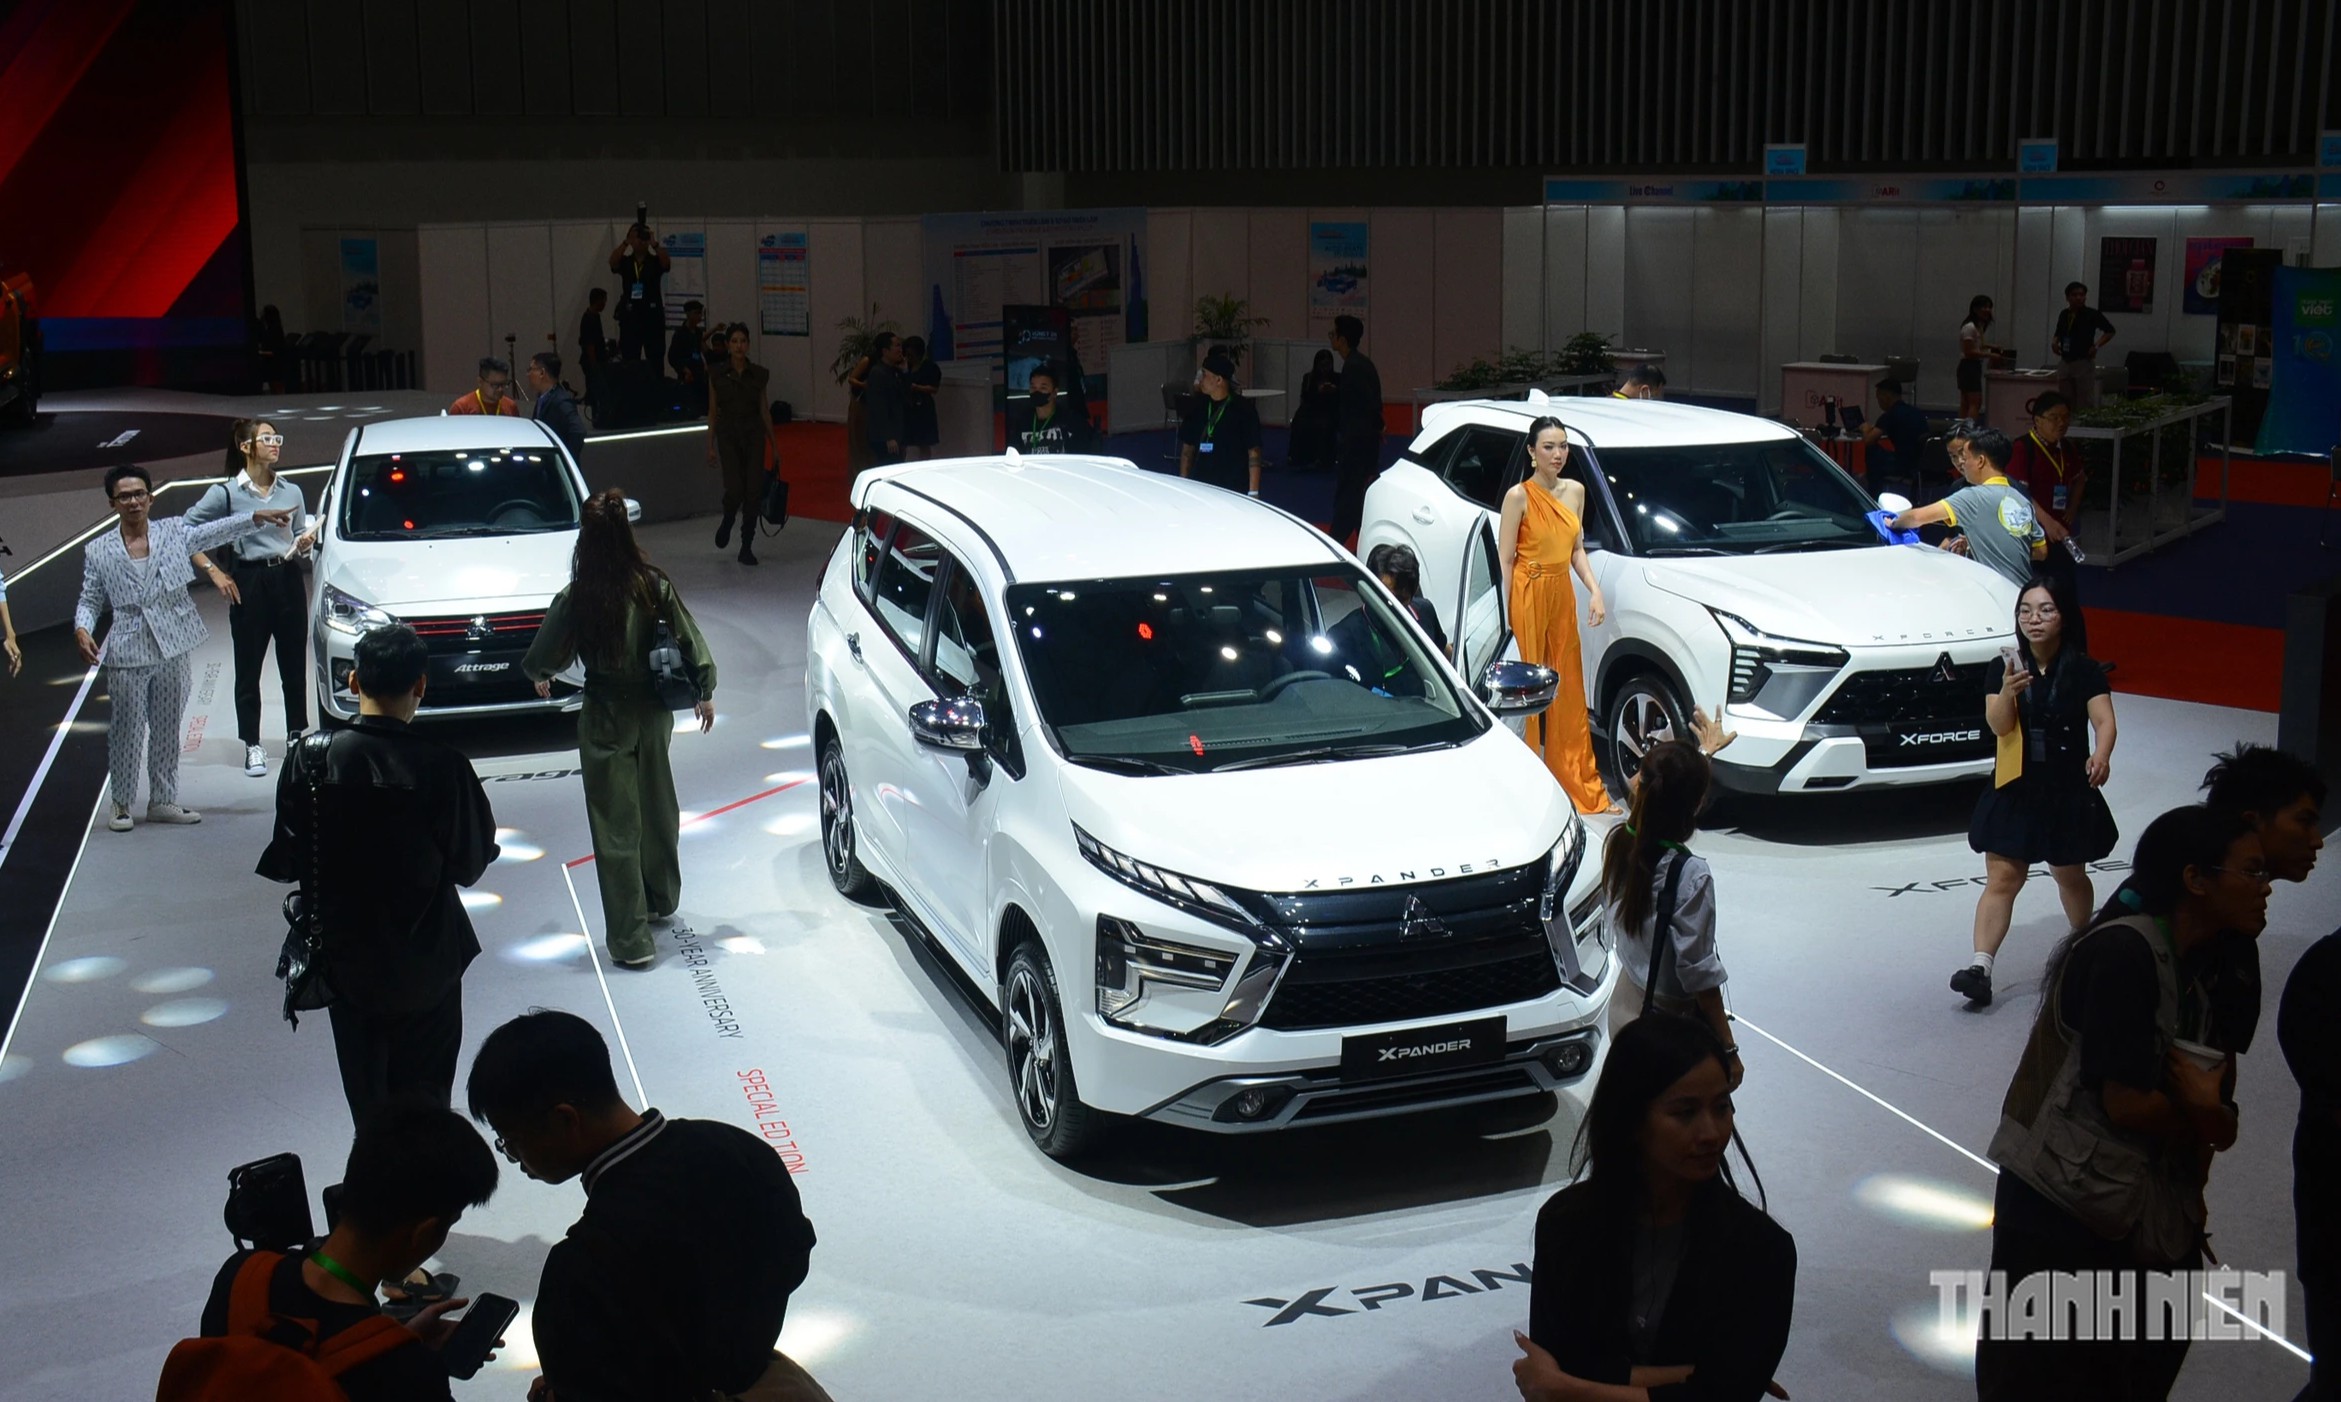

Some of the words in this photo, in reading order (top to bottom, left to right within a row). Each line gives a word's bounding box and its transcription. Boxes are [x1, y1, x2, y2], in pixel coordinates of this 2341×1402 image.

[454, 662, 510, 673] Attrage
[1900, 729, 1981, 747] XFORCE
[1304, 858, 1501, 889] XPANDER
[672, 927, 709, 968] 30-YEAR
[691, 968, 744, 1040] ANNIVERSARY
[1377, 1039, 1472, 1063] XPANDER
[737, 1067, 780, 1119] SPECIAL
